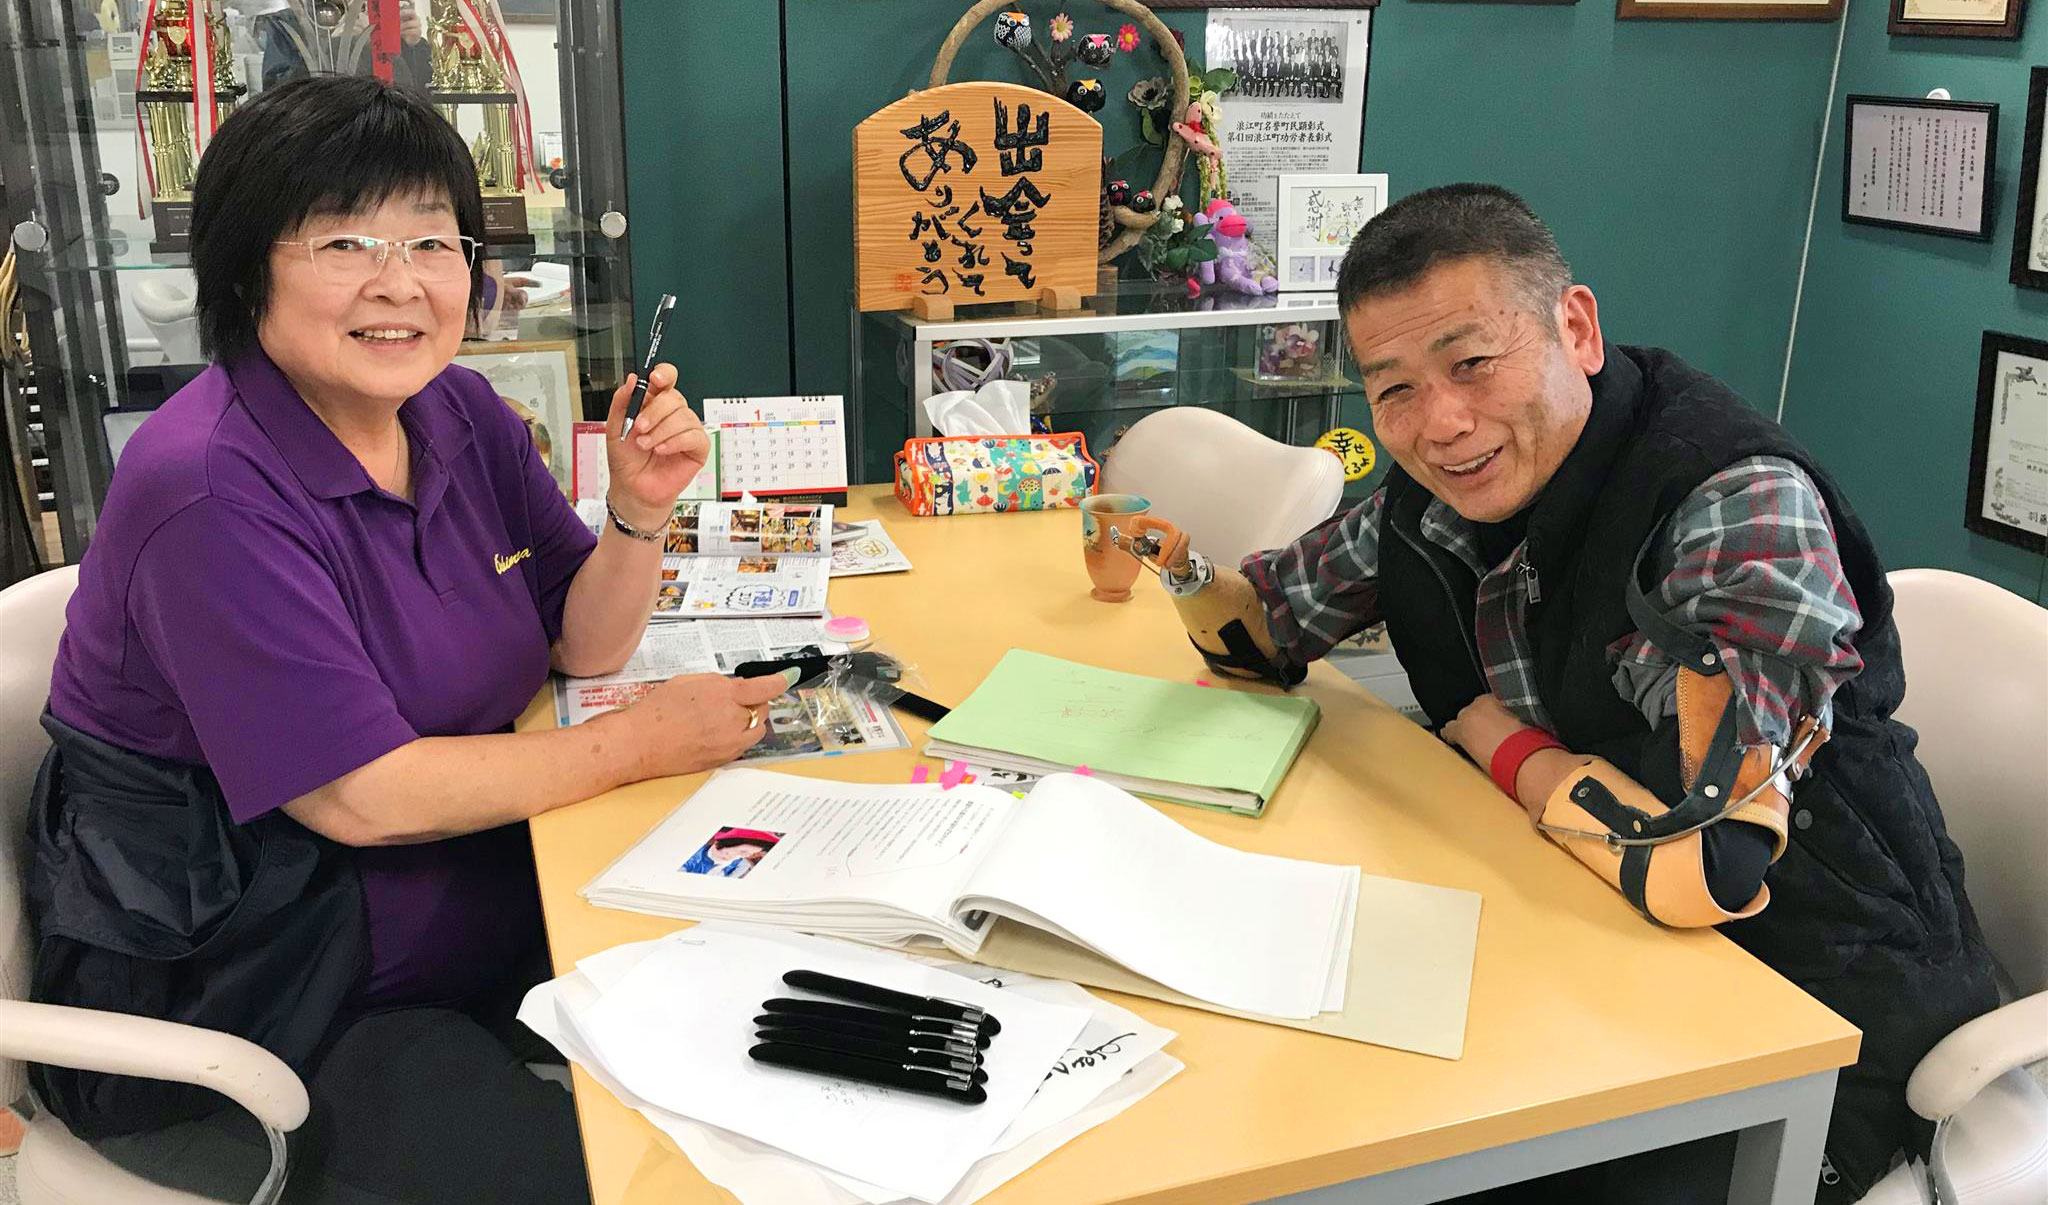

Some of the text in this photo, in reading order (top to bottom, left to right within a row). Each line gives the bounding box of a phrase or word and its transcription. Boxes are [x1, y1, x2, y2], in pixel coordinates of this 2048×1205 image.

[1227, 132, 1333, 142] 第41回浪江町功労者表彰式
[1236, 121, 1325, 131] 浪江町名誉町民顕彰式
[899, 110, 978, 294] ありがとう
[1305, 190, 1325, 242] 感謝
[951, 201, 990, 296] くれて
[754, 409, 761, 421] 1
[1329, 431, 1365, 460] 幸せ
